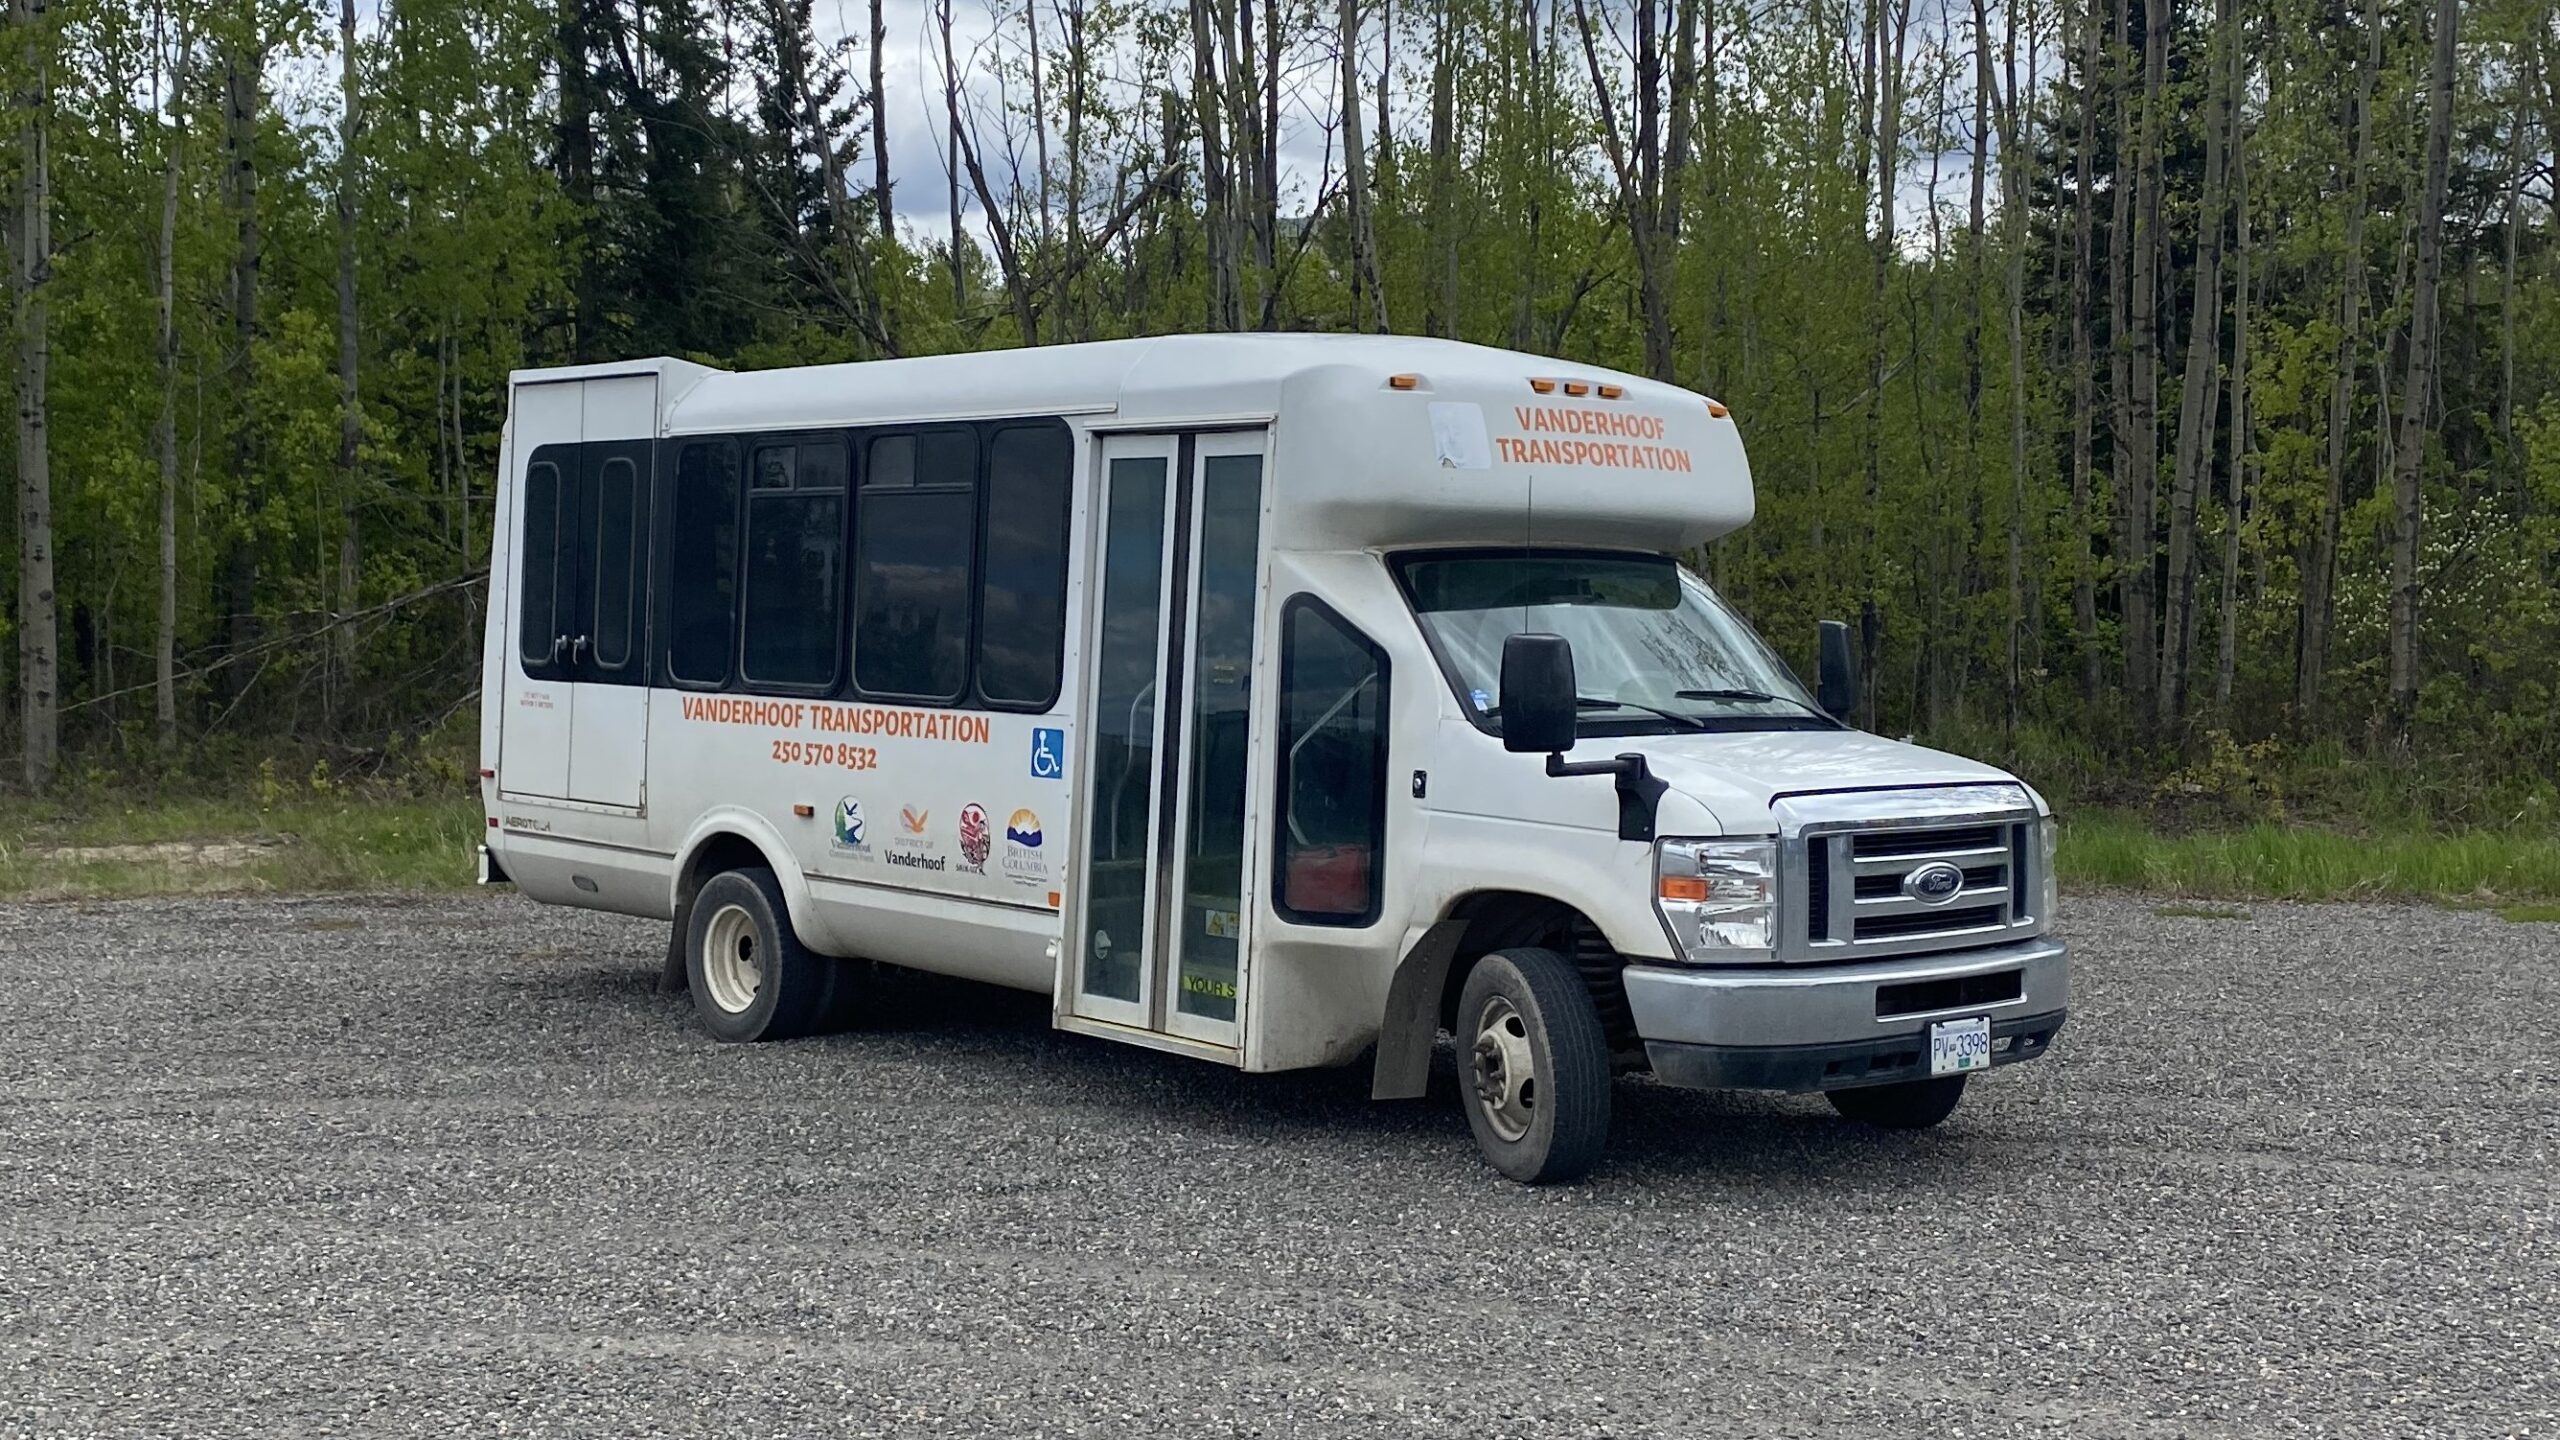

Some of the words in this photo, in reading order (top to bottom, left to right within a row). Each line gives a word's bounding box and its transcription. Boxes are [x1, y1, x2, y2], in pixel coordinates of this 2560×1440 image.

[1514, 406, 1665, 440] VANDERHOOF
[1496, 437, 1692, 473] TRANSPORTATION
[682, 696, 804, 728] VANDERHOOF
[810, 705, 990, 743] TRANSPORTATION
[772, 740, 800, 763] 250
[803, 743, 833, 766] 570
[837, 743, 877, 770] 8532
[884, 849, 946, 872] Vanderhoof
[1007, 845, 1042, 860] BRITISH
[1929, 873, 1953, 891] Ford
[1188, 976, 1223, 995] YOUR
